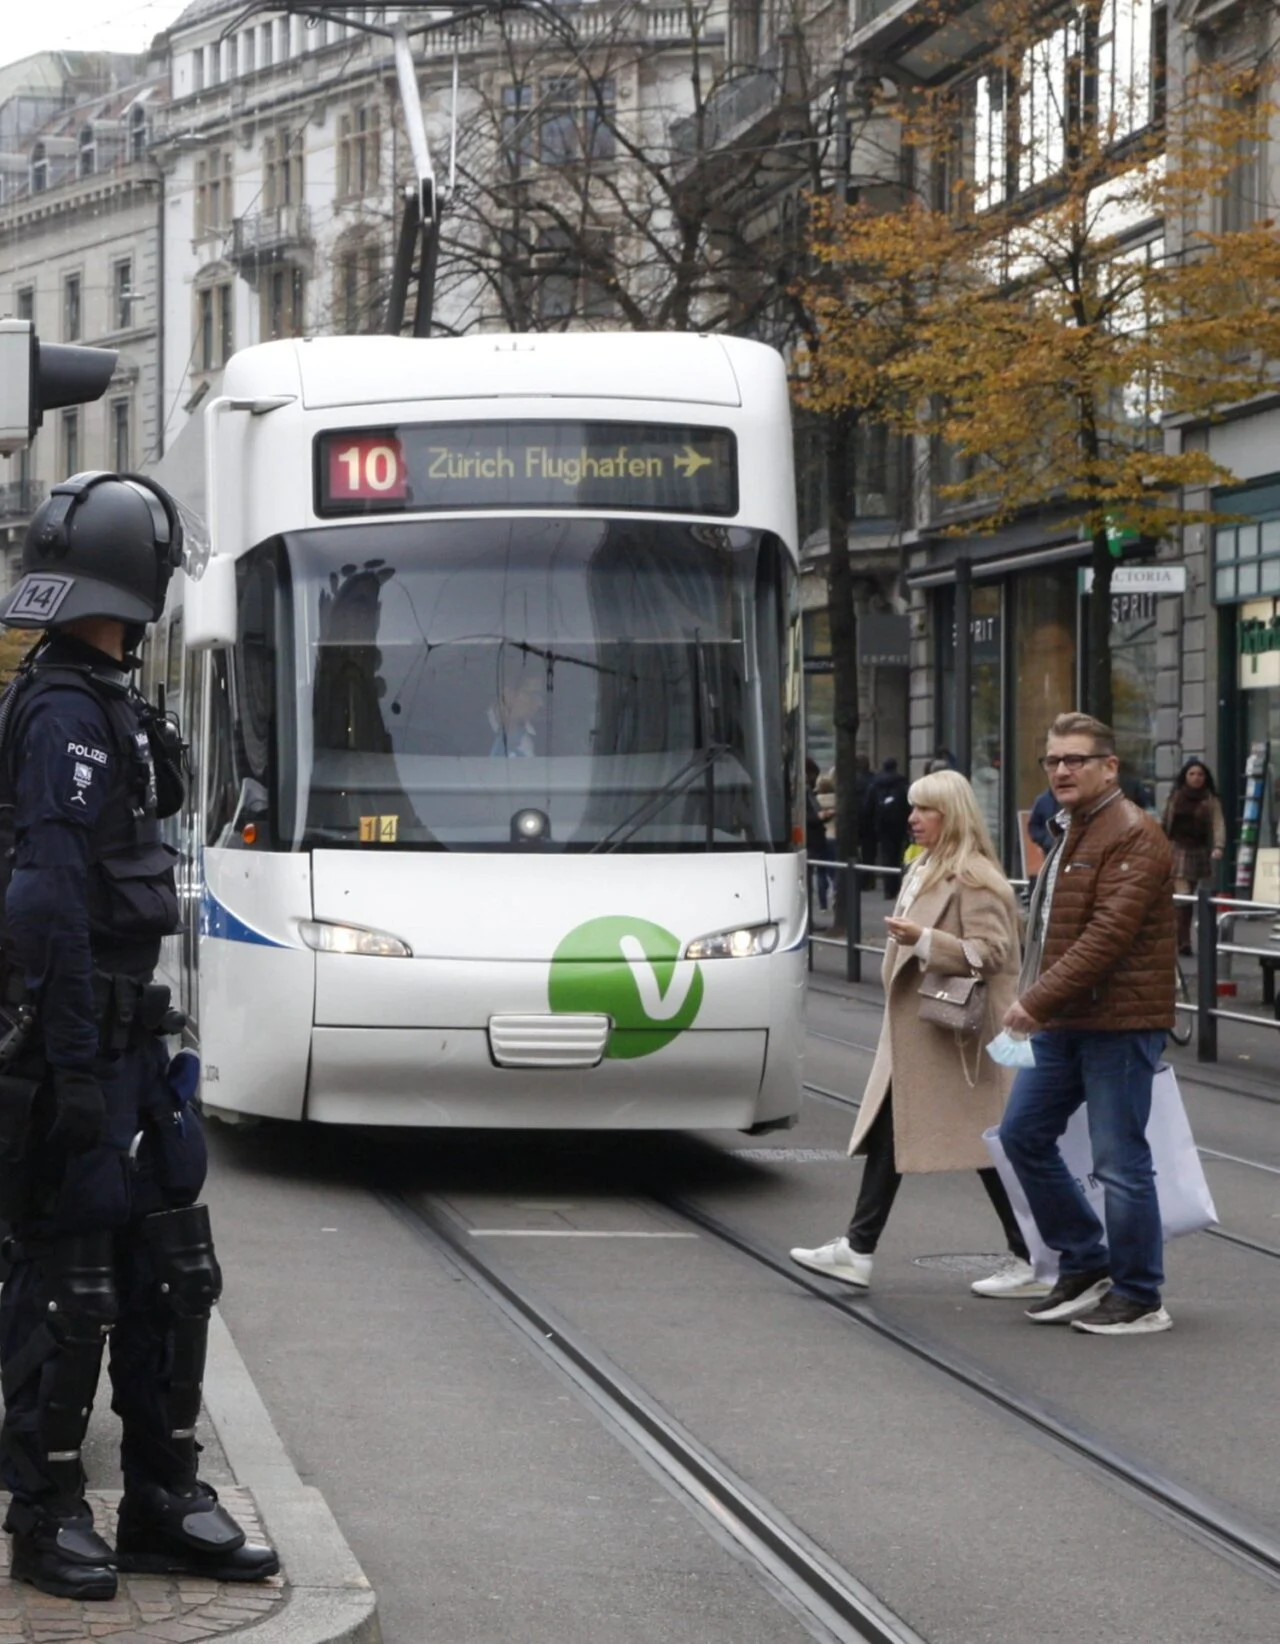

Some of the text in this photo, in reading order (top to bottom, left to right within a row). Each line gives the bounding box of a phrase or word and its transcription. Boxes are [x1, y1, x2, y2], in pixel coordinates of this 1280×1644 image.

[337, 446, 397, 491] 10
[428, 445, 662, 485] Zürich Flughafen
[1115, 571, 1172, 583] CTORIA
[24, 585, 56, 608] 14
[1111, 592, 1155, 624] SPRIT
[67, 742, 108, 764] POLIZEI
[363, 818, 396, 841] 14
